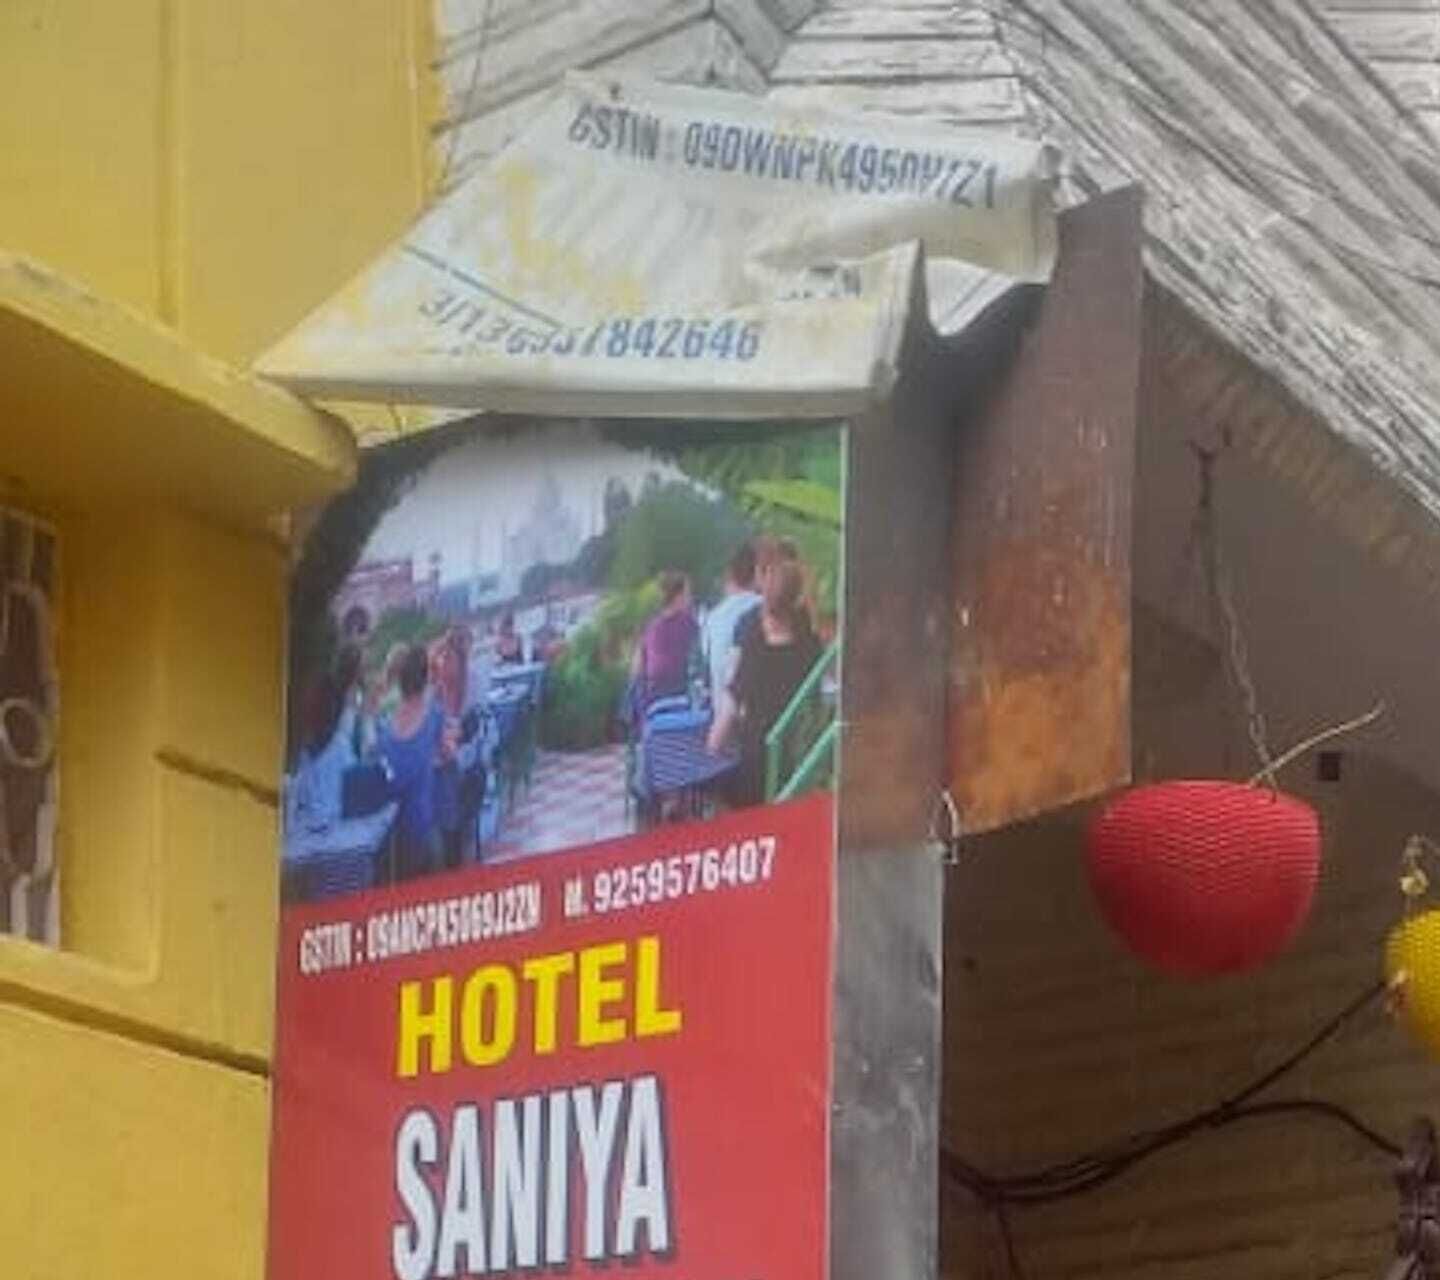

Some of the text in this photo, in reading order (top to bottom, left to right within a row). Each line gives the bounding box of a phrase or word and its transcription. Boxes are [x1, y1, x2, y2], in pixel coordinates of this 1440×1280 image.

[568, 104, 661, 162] GSTIN
[300, 921, 352, 975] GSTIN
[593, 835, 777, 912] 9259576407
[396, 936, 683, 1077] HOTEL
